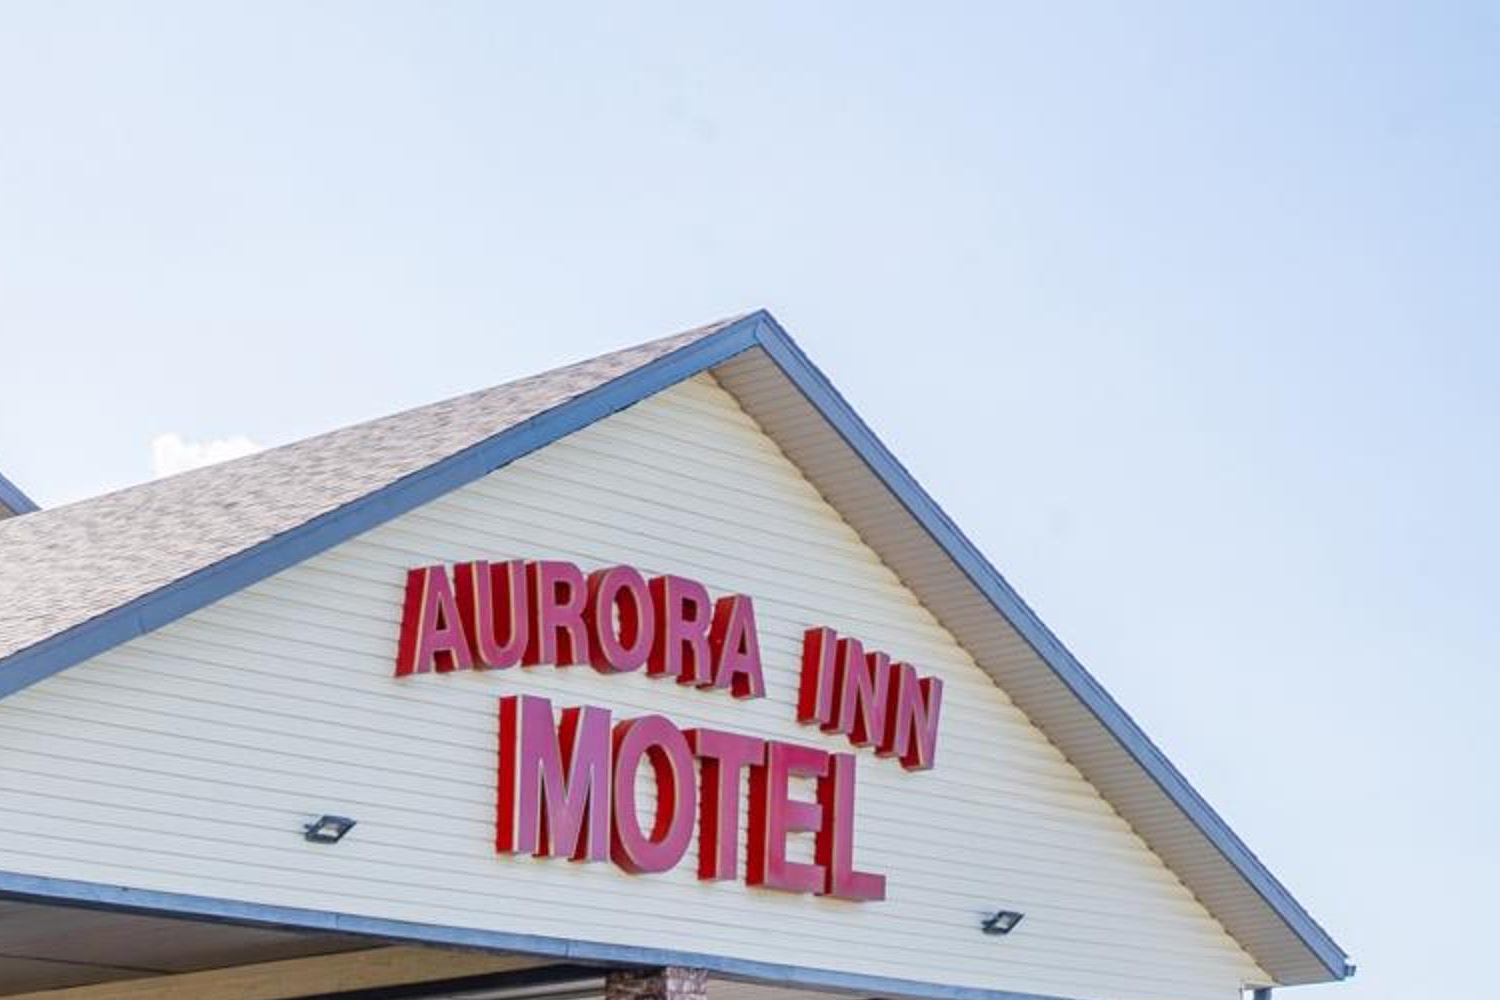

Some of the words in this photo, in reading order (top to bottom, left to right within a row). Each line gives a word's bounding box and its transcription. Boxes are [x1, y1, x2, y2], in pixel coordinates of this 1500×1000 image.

[396, 560, 766, 698] AURORA
[797, 626, 943, 771] INN
[496, 694, 886, 901] MOTEL
